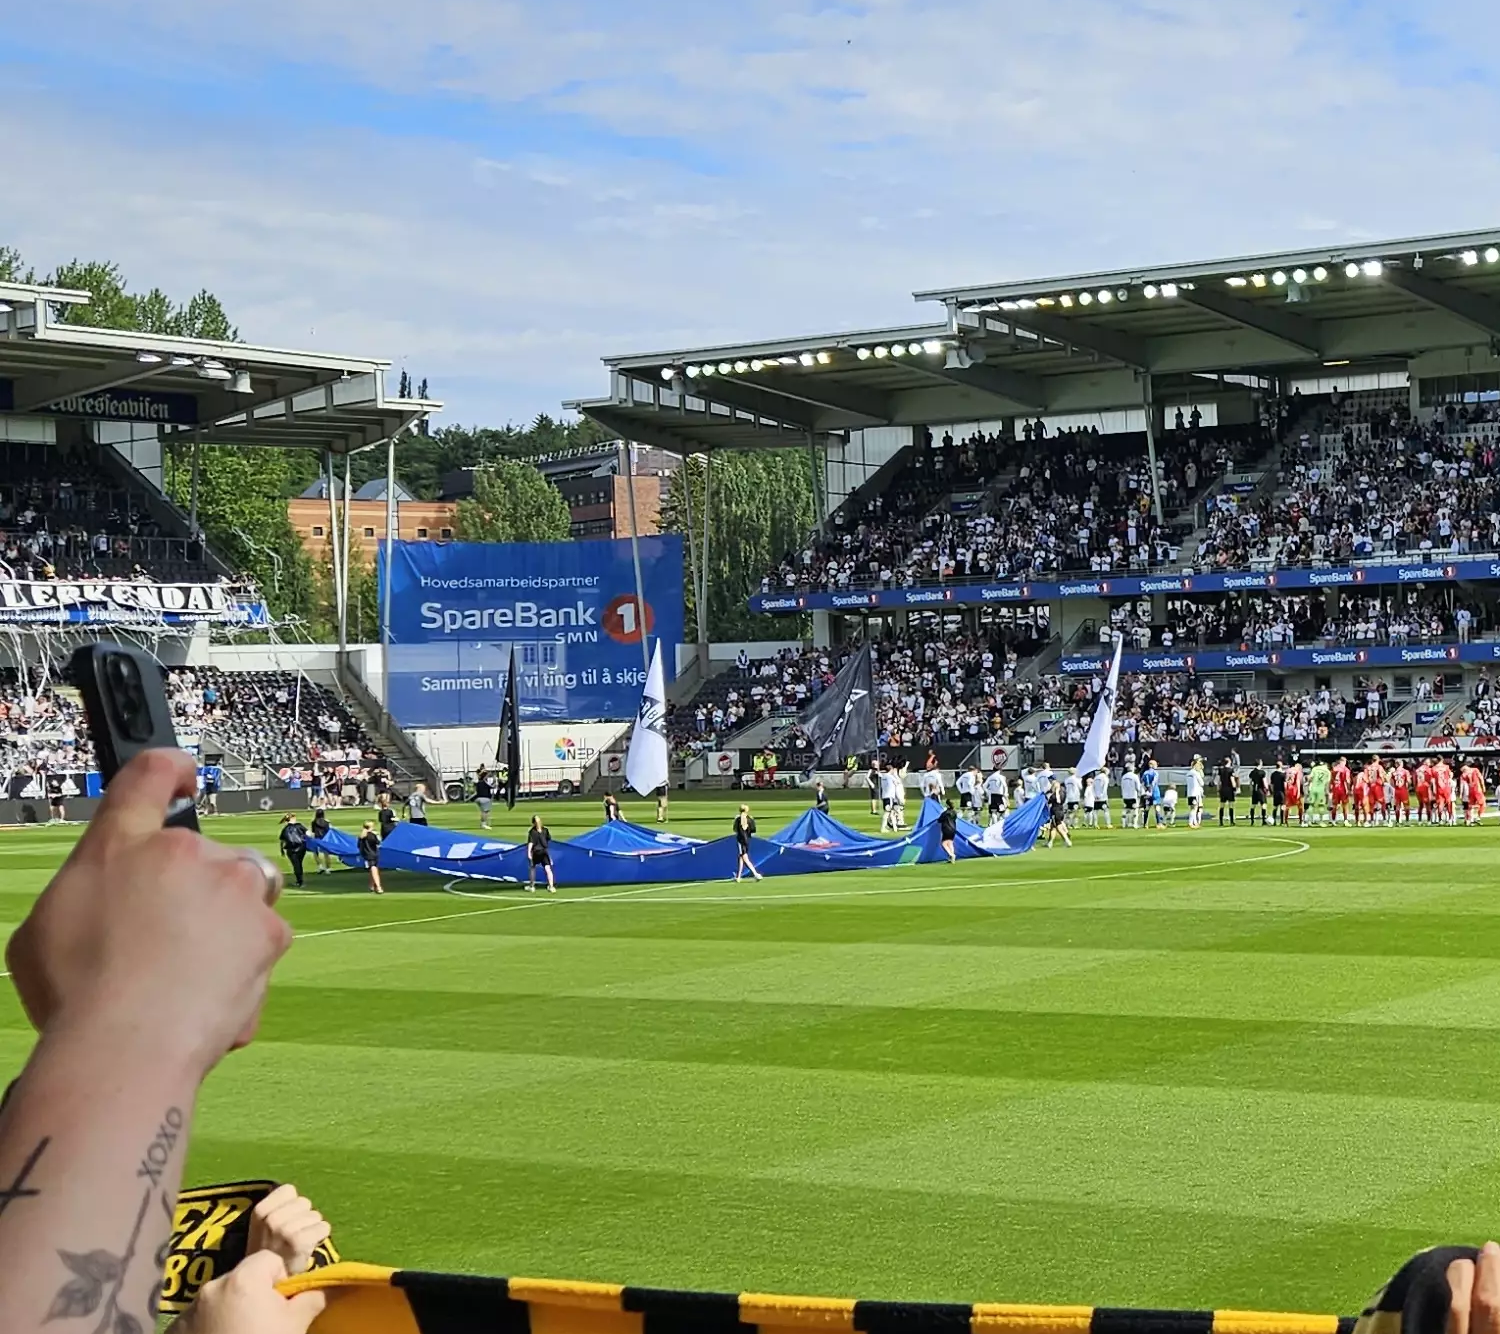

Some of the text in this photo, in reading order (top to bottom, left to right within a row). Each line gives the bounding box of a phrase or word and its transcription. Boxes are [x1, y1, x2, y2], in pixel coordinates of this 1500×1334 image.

[1310, 572, 1353, 585] SpareBank
[1399, 567, 1444, 580] SpareBank
[420, 575, 599, 589] Hovedsamarbeidspartner
[1140, 580, 1181, 592] SpareBank
[1224, 576, 1265, 588] SpareBank
[982, 588, 1020, 599] SpareBank
[1060, 584, 1100, 595] SpareBank
[832, 596, 869, 606] SpareBank
[906, 592, 943, 602] SpareBank
[762, 599, 796, 609] SpareBank
[421, 601, 636, 634] SpareBank 1
[555, 631, 598, 644] SMN
[1227, 655, 1268, 666] SpareBank
[1312, 652, 1356, 664] SpareBank
[1402, 649, 1446, 661] SpareBank
[1062, 660, 1102, 672] SpareBank
[1143, 658, 1184, 669] SpareBank
[421, 677, 493, 692] Sammen
[524, 671, 538, 687] vi
[542, 671, 577, 689] ting
[582, 668, 597, 685] til
[602, 669, 612, 685] å
[616, 667, 647, 688] skje
[567, 748, 594, 761] NEP
[137, 1106, 183, 1188] XOXO
